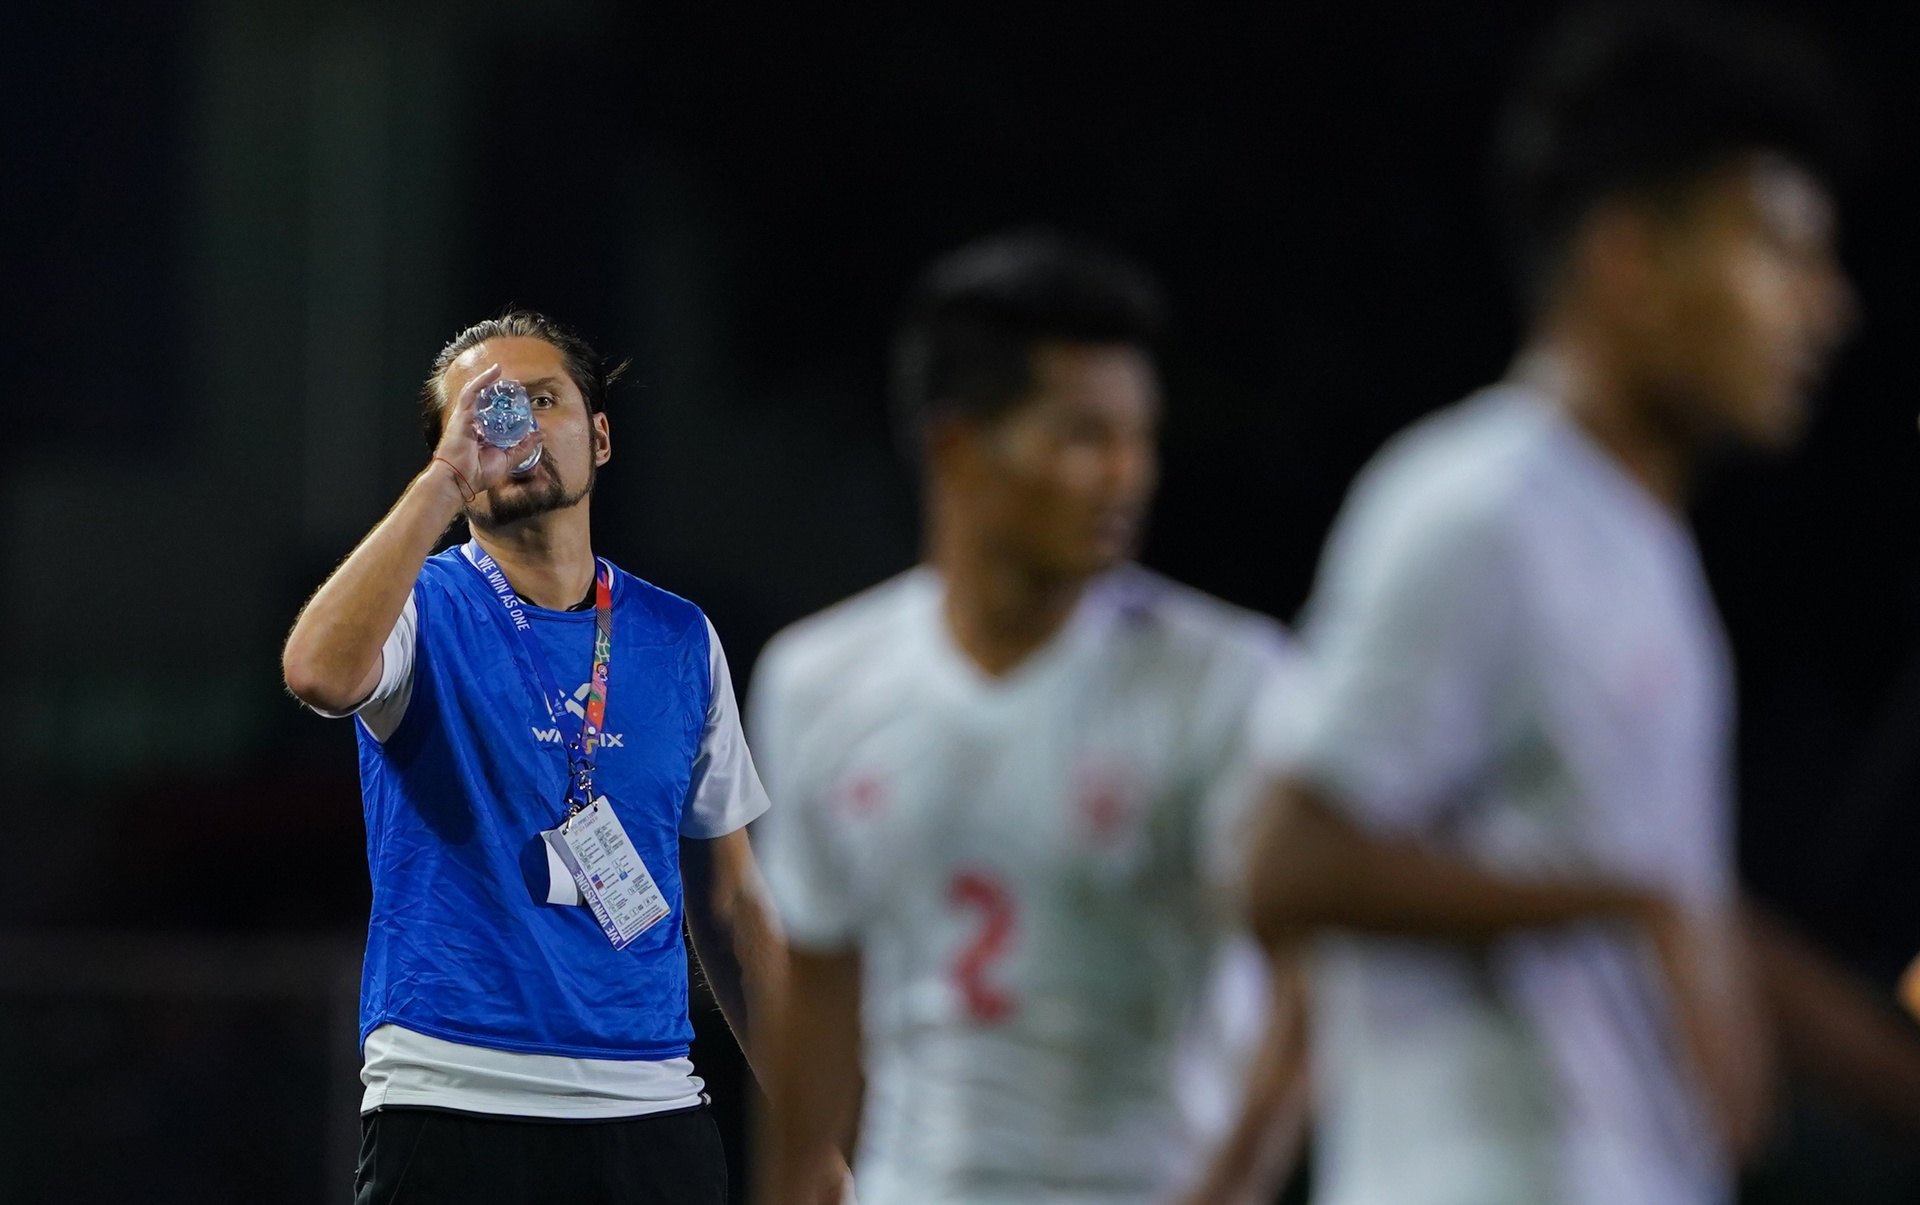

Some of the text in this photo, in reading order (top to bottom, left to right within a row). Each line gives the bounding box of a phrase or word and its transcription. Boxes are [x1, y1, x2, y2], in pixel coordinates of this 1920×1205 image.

[477, 554, 531, 632] WE WIN AS ONE
[573, 870, 590, 892] ONE
[584, 889, 599, 905] AS
[592, 903, 611, 928] WIN
[605, 924, 621, 946] WE
[946, 869, 1018, 1025] 2
